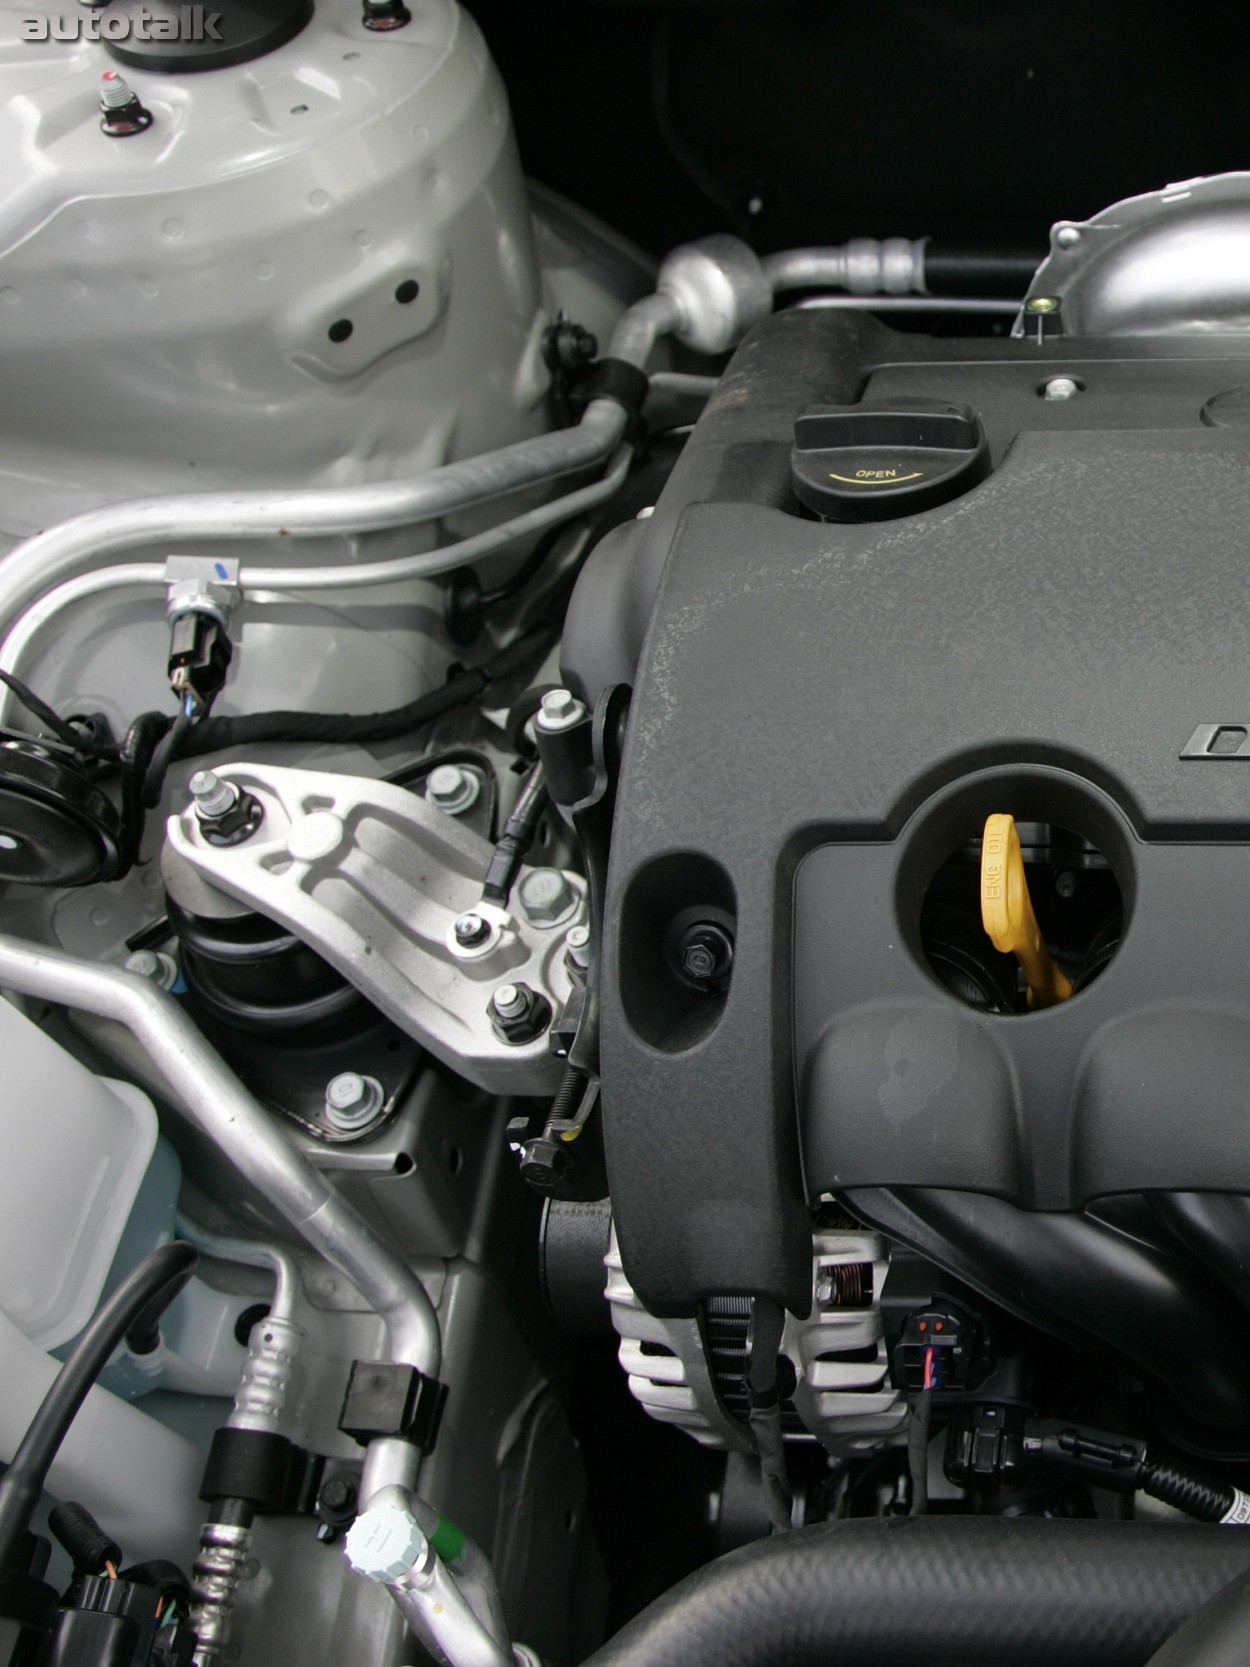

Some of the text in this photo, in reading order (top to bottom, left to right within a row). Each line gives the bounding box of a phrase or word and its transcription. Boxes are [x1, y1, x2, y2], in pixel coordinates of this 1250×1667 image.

[855, 469, 896, 478] OPEN
[985, 823, 1004, 900] ENG OIL
